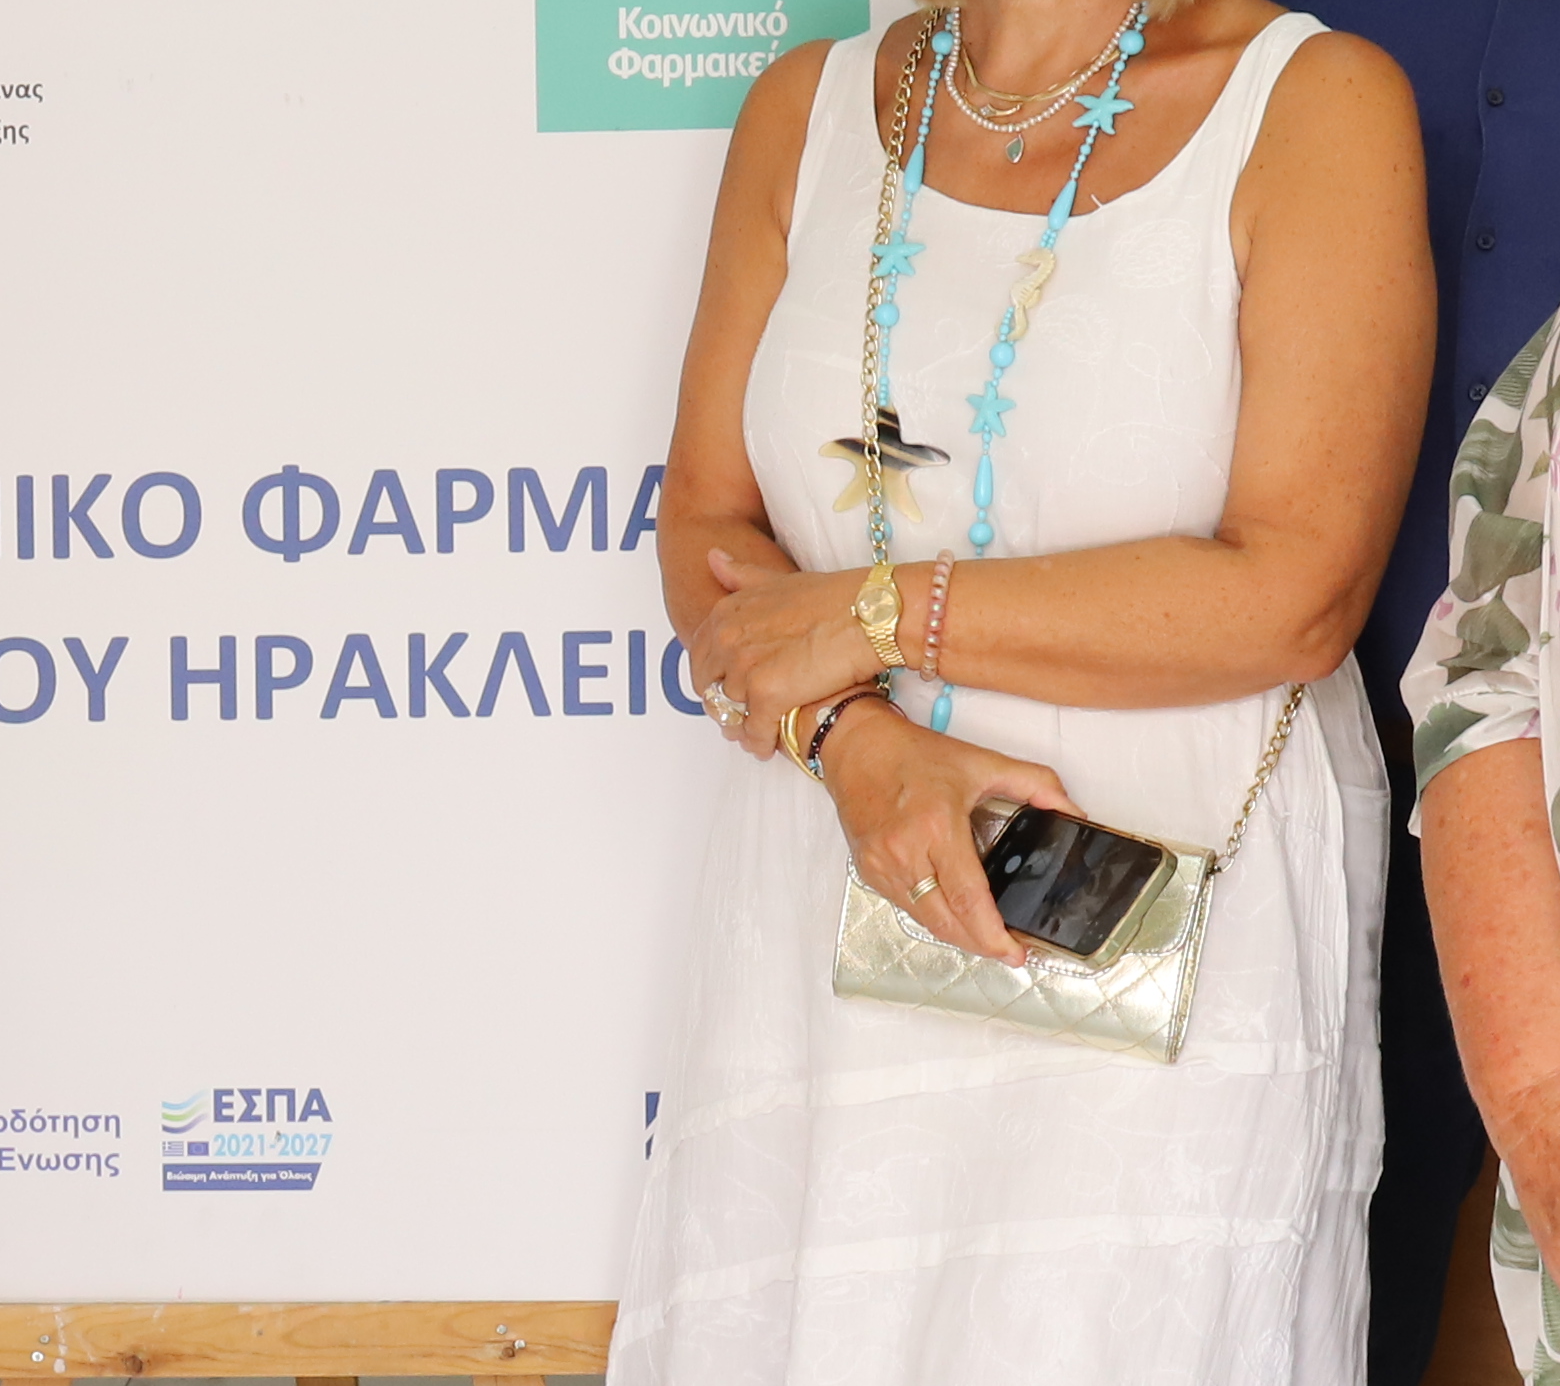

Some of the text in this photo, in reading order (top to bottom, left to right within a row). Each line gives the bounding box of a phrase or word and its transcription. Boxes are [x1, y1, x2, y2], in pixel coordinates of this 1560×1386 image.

[618, 0, 789, 40] Κοινωνικό
[608, 40, 784, 88] Φαρμακεί
[213, 1088, 333, 1123] ΕΣΠΑ
[213, 1133, 333, 1157] 2021-2027
[166, 1169, 313, 1183] Βιώσιμη Ανάπτυξη για Όλους
